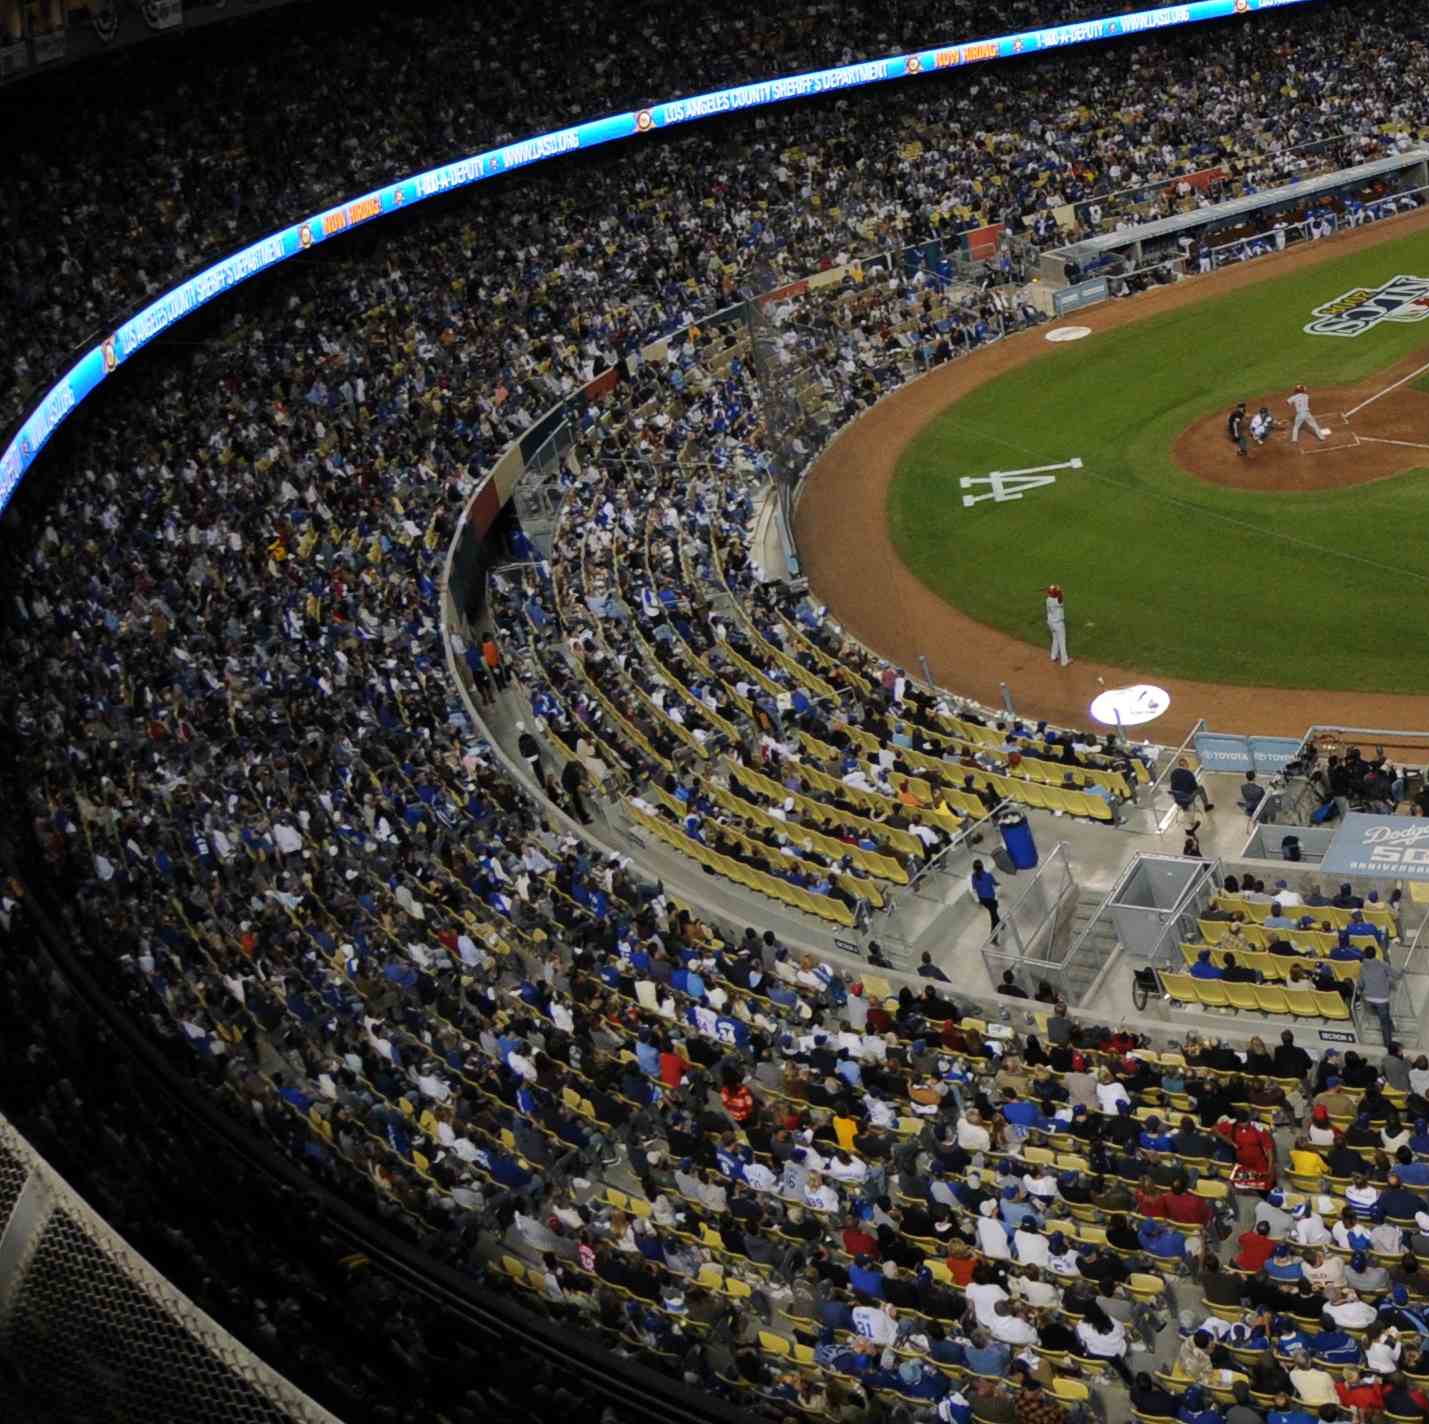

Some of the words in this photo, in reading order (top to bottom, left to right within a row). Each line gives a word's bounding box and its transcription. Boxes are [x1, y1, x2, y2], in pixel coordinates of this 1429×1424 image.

[663, 108, 684, 123] LOS
[686, 94, 730, 119] ANGELES
[730, 84, 770, 108] COUNTY
[823, 62, 888, 90] DEPARTMENT
[1212, 750, 1249, 762] TOYOTA
[856, 1321, 874, 1339] 31
